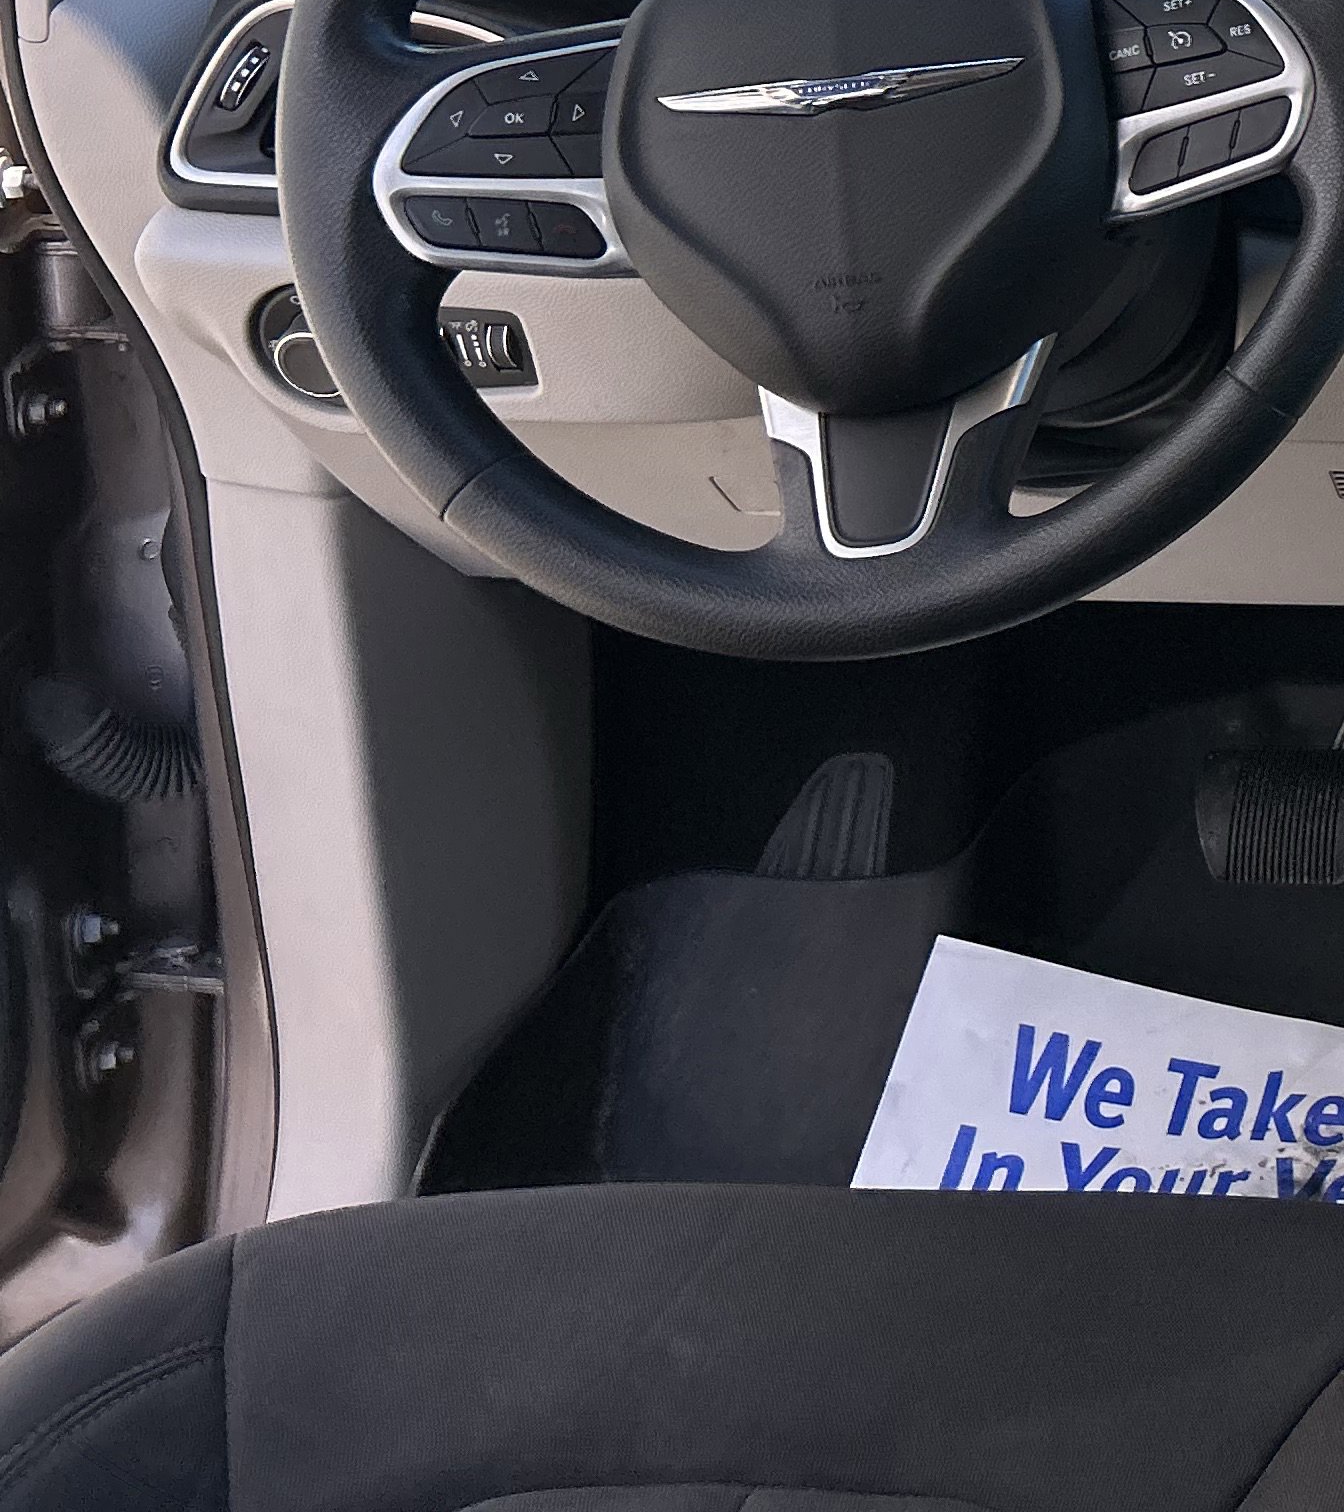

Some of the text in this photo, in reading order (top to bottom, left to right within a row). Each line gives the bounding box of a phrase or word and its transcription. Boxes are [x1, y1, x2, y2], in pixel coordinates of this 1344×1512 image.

[1229, 23, 1252, 38] RES
[1108, 43, 1141, 61] CANC
[504, 112, 525, 125] OK
[1009, 1023, 1135, 1129] We
[939, 1124, 1025, 1192] In
